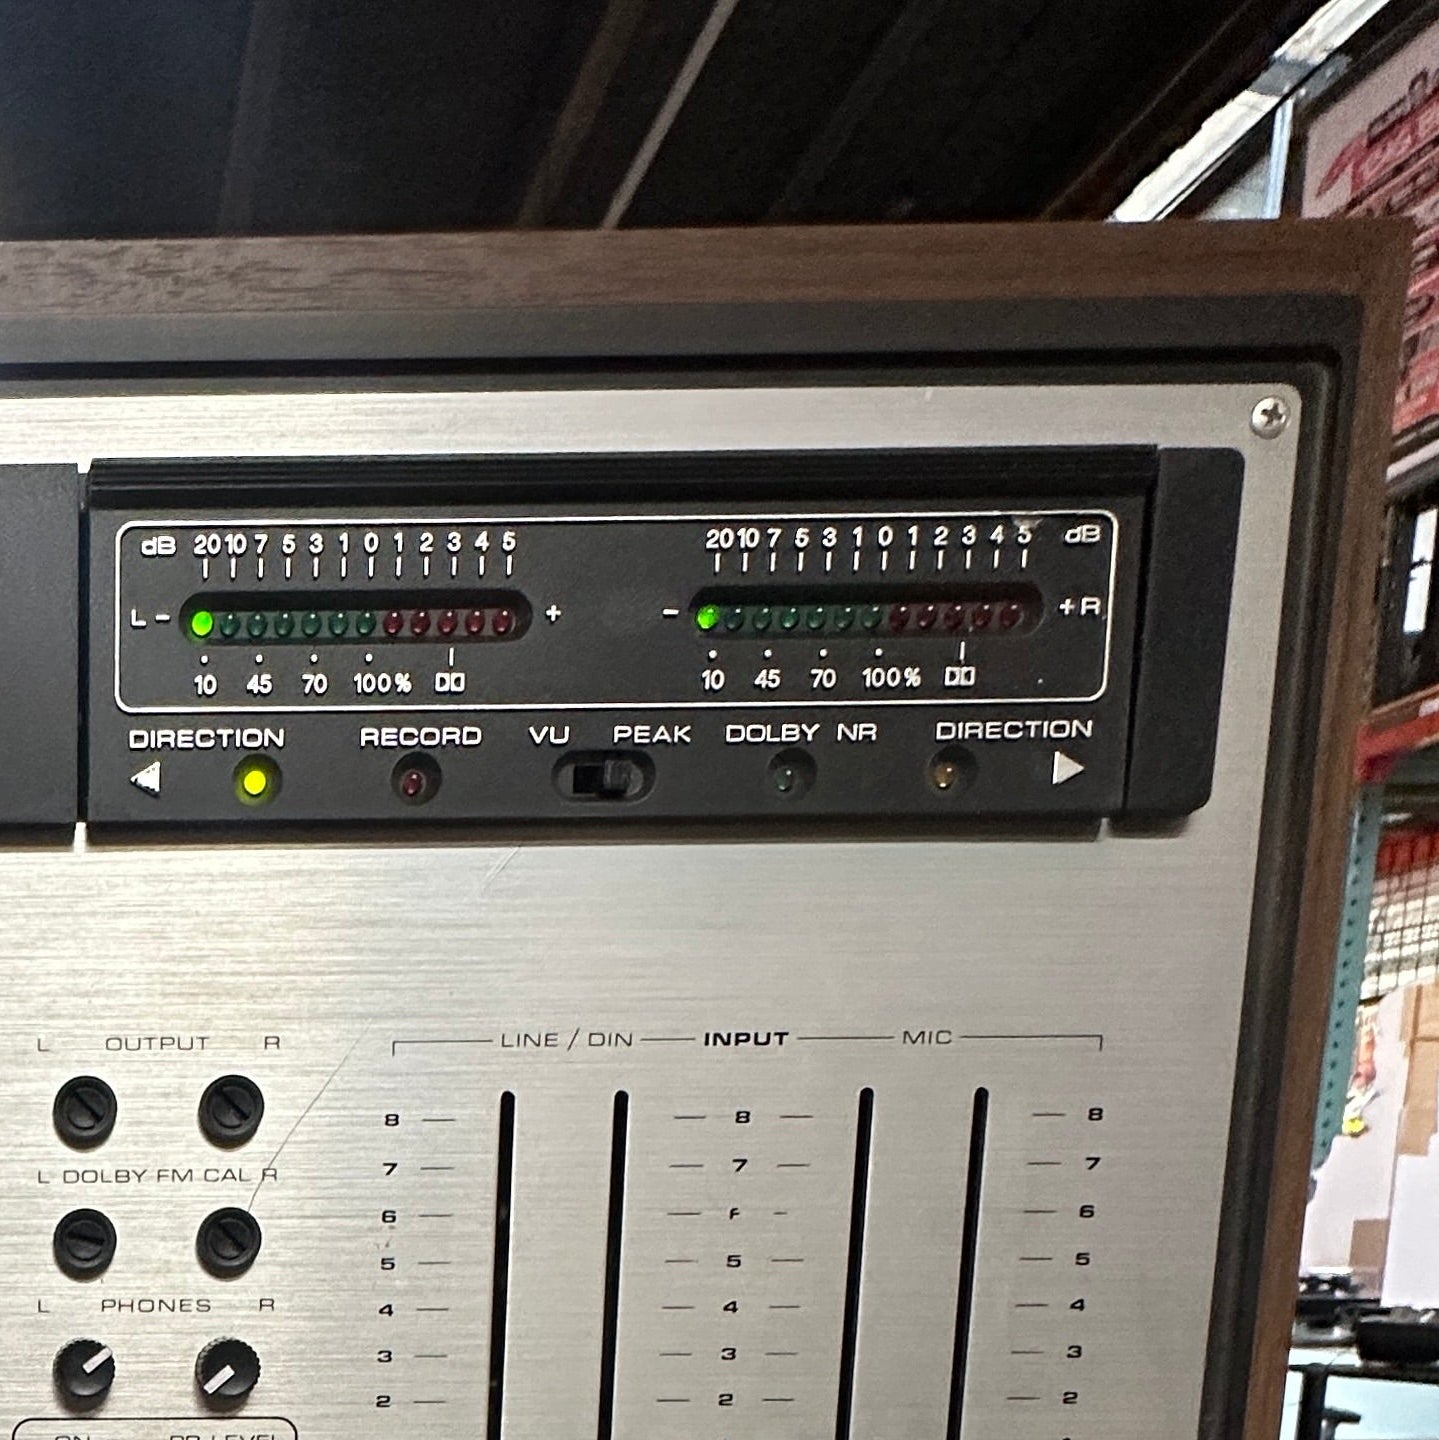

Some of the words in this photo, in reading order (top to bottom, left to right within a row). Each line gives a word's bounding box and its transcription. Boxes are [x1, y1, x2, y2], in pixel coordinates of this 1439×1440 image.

[142, 536, 176, 555] dB
[194, 533, 221, 554] 20
[225, 534, 246, 554] 10
[255, 534, 268, 553] 7
[283, 534, 295, 553] 5
[309, 533, 323, 553] 3
[340, 532, 348, 552] 1
[364, 532, 378, 552] 0
[394, 532, 402, 552] 1
[420, 532, 433, 552] 2
[447, 532, 461, 551] 3
[475, 531, 489, 551] 4
[503, 531, 515, 550] 5
[706, 528, 734, 548] 20
[737, 528, 760, 548] 10
[767, 528, 781, 547] 7
[795, 528, 809, 547] 5
[823, 527, 837, 547] 3
[853, 526, 862, 546] 1
[879, 526, 893, 546] 0
[909, 526, 918, 545] 1
[934, 526, 948, 545] 2
[962, 525, 976, 544] 3
[990, 525, 1004, 544] 4
[1065, 525, 1100, 543] dB
[195, 675, 216, 694] 10
[247, 674, 272, 693] 45
[302, 673, 327, 693] 70
[702, 670, 724, 689] 10
[755, 669, 780, 688] 45
[811, 669, 836, 687] 70
[361, 726, 481, 746] RECORD
[529, 726, 569, 743] VU
[614, 726, 691, 743] PEAK
[726, 724, 820, 742] DOLBY
[838, 724, 877, 740] NR
[936, 720, 1092, 739] DIRECTION
[130, 728, 284, 748] DIRECTION
[502, 1033, 558, 1047] LINE
[589, 1033, 632, 1046] DIN
[705, 1032, 789, 1046] INPUT
[903, 1030, 951, 1044] MIC
[38, 1039, 50, 1052] L
[106, 1037, 209, 1051] OUTPUT
[265, 1036, 280, 1049] R
[385, 1114, 399, 1126] 8
[736, 1111, 750, 1123] 8
[1088, 1108, 1103, 1121] 8
[383, 1163, 397, 1175] 7
[733, 1159, 747, 1172] 7
[1086, 1157, 1100, 1170] 7
[38, 1171, 49, 1183] L
[63, 1170, 147, 1183] DOLBY
[157, 1169, 192, 1182] FM
[204, 1168, 250, 1182] CAL
[262, 1167, 277, 1181] R
[382, 1210, 396, 1223] 6
[1080, 1205, 1094, 1218] 6
[381, 1258, 395, 1270] 5
[727, 1255, 741, 1267] 5
[1076, 1253, 1089, 1265] 5
[38, 1300, 49, 1313] L
[102, 1299, 210, 1312] PHONES
[260, 1299, 274, 1311] R
[379, 1304, 393, 1316] 4
[723, 1301, 738, 1313] 4
[1070, 1299, 1084, 1311] 4
[378, 1351, 392, 1362] 3
[722, 1348, 736, 1360] 3
[1067, 1345, 1081, 1358] 3
[376, 1396, 390, 1407] 2
[719, 1394, 733, 1406] 2
[1063, 1392, 1077, 1404] 2
